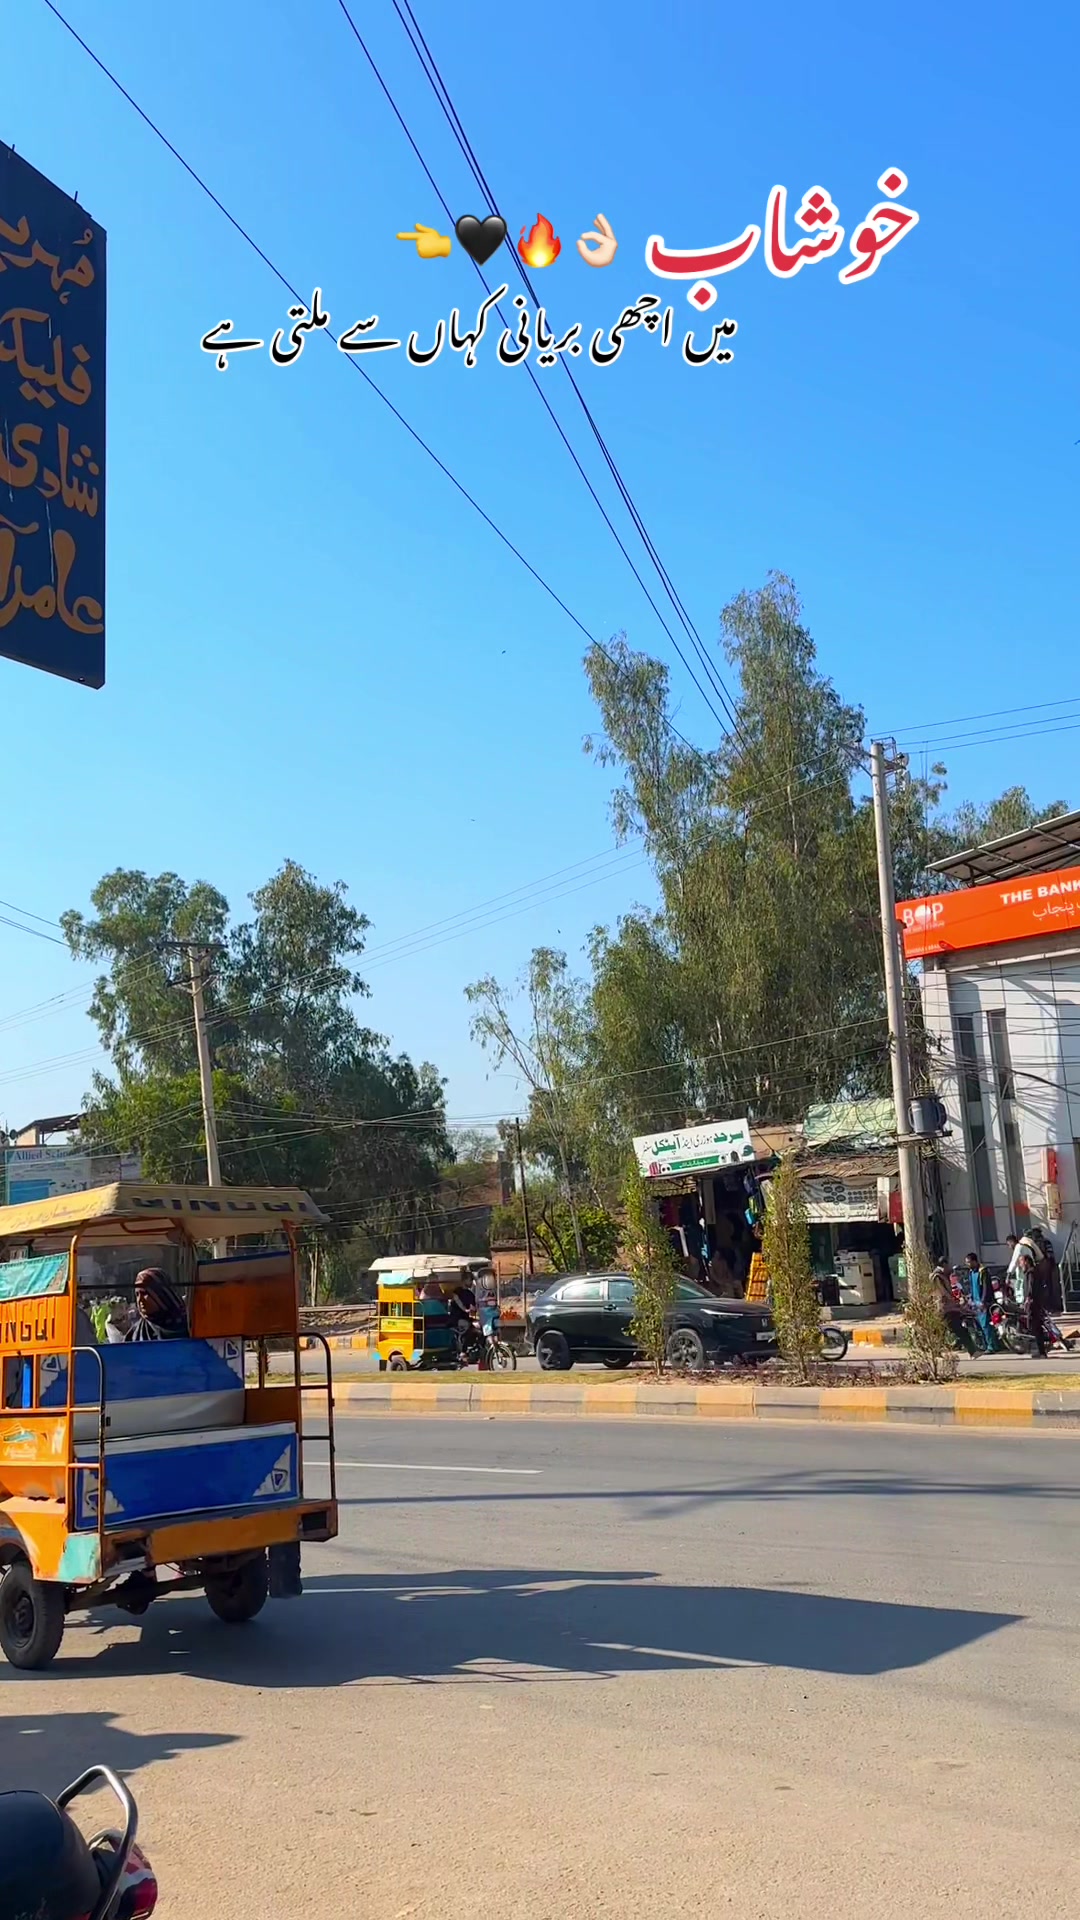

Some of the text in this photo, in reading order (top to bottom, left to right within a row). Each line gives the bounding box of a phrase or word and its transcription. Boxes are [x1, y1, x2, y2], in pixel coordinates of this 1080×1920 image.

[1000, 888, 1033, 905] THE
[1032, 901, 1075, 921] پنجاب
[14, 1151, 43, 1161] Allied
